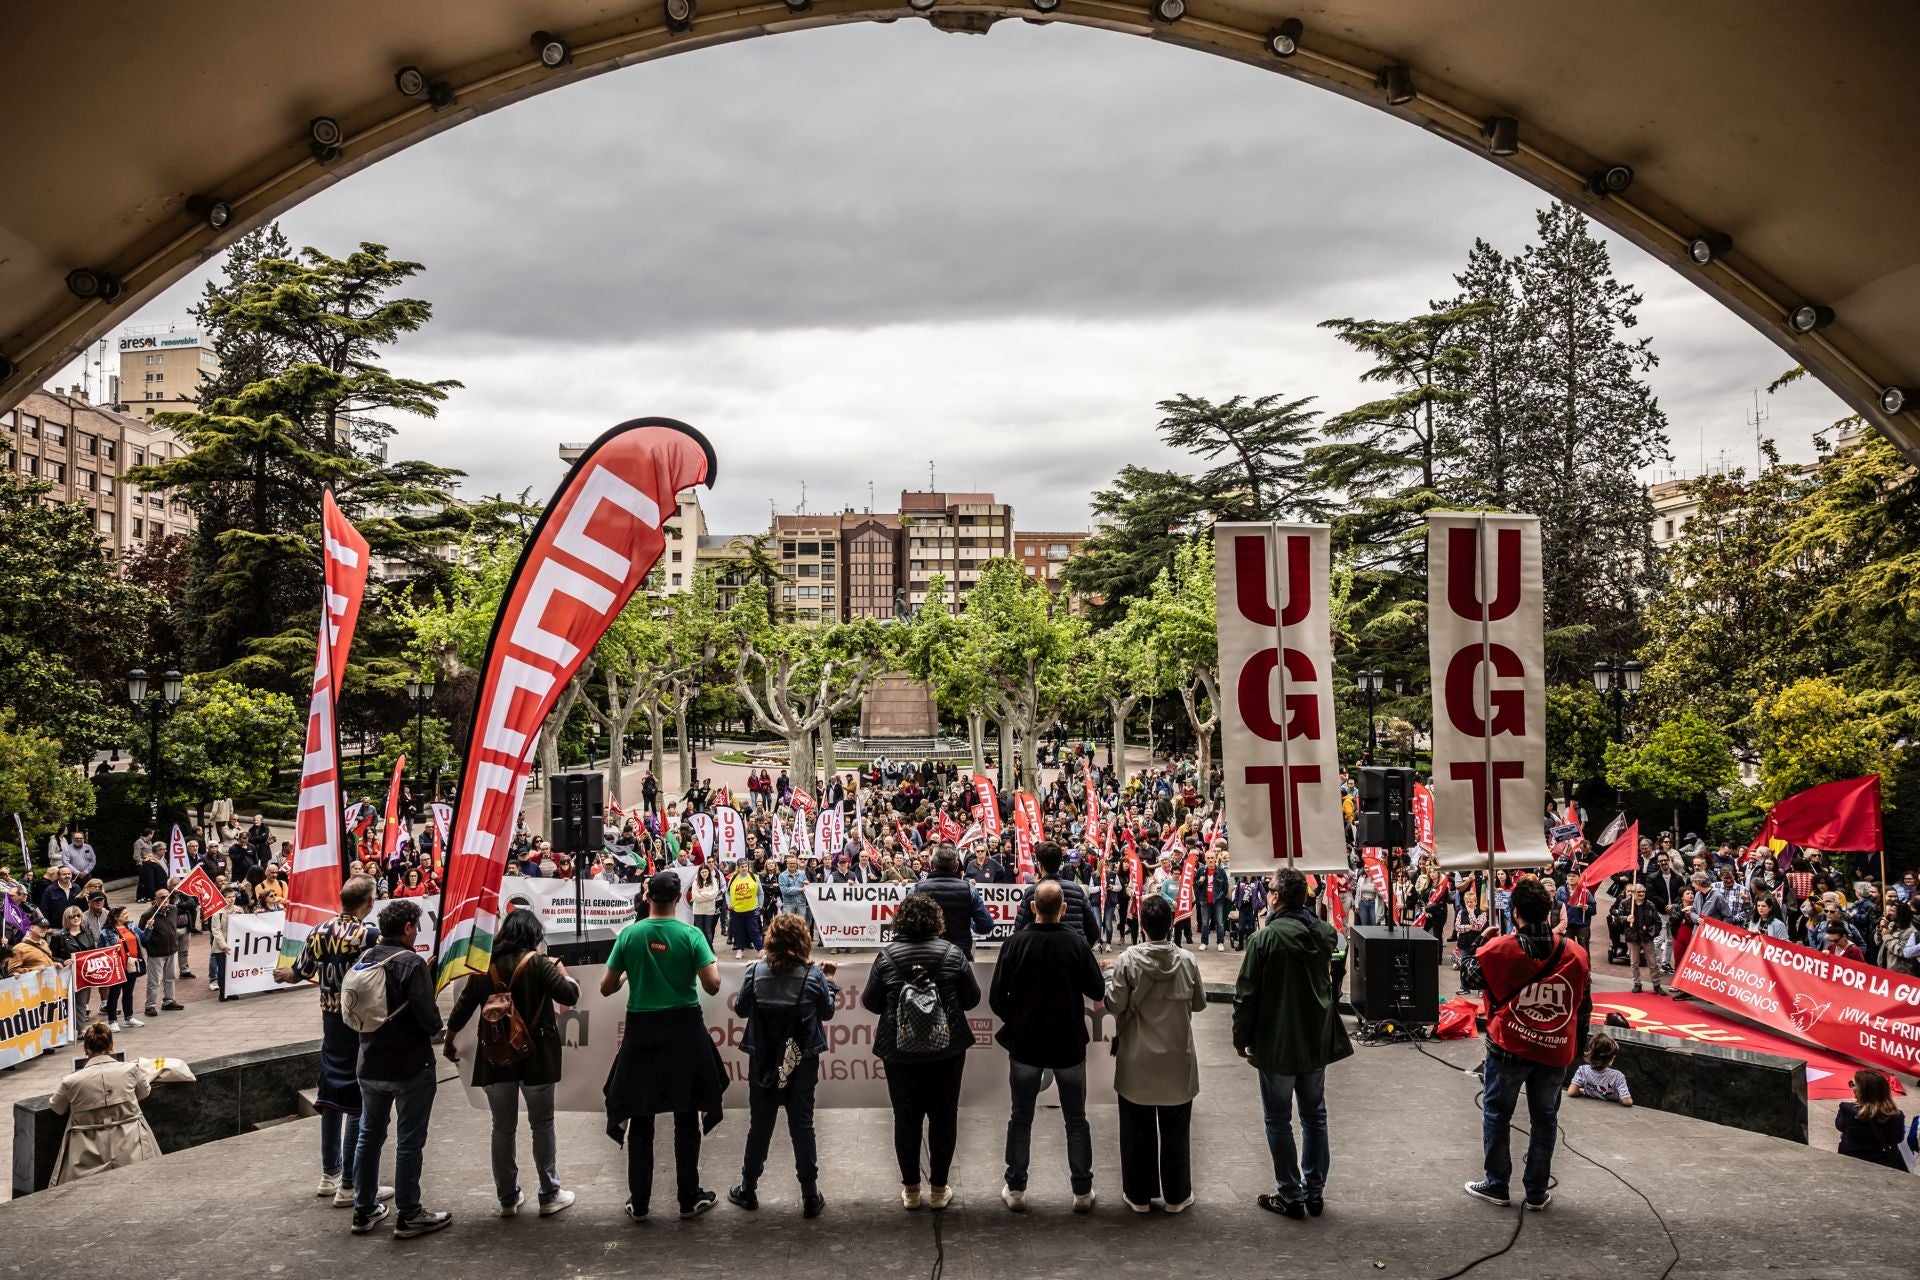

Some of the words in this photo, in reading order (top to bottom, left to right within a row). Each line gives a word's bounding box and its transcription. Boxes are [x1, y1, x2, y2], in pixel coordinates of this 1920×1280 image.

[120, 337, 157, 349] aresol
[161, 337, 198, 347] renovables
[1235, 536, 1321, 859] UGT
[1445, 528, 1526, 854] UGT
[822, 814, 831, 849] UGT
[173, 829, 185, 867] UGT
[818, 887, 836, 901] LA
[843, 887, 899, 901] HUCHA
[87, 956, 110, 972] UGT
[231, 968, 250, 979] UGT
[1688, 952, 1706, 968] PAZ,
[1708, 959, 1765, 989] SALARIOS
[1768, 981, 1776, 993] Y
[1700, 925, 1763, 956] NINGÚN
[1763, 944, 1828, 979] RECORTE
[1832, 965, 1866, 990] POR
[1869, 975, 1889, 997] LA
[1519, 983, 1566, 1007] UGT
[1681, 967, 1726, 993] EMPLEOS
[1727, 984, 1779, 1013] DIGNOS
[1508, 1021, 1537, 1038] mano
[1839, 1007, 1870, 1027] ¡VIVA
[1873, 1016, 1888, 1032] EL
[1860, 1031, 1877, 1050] DE
